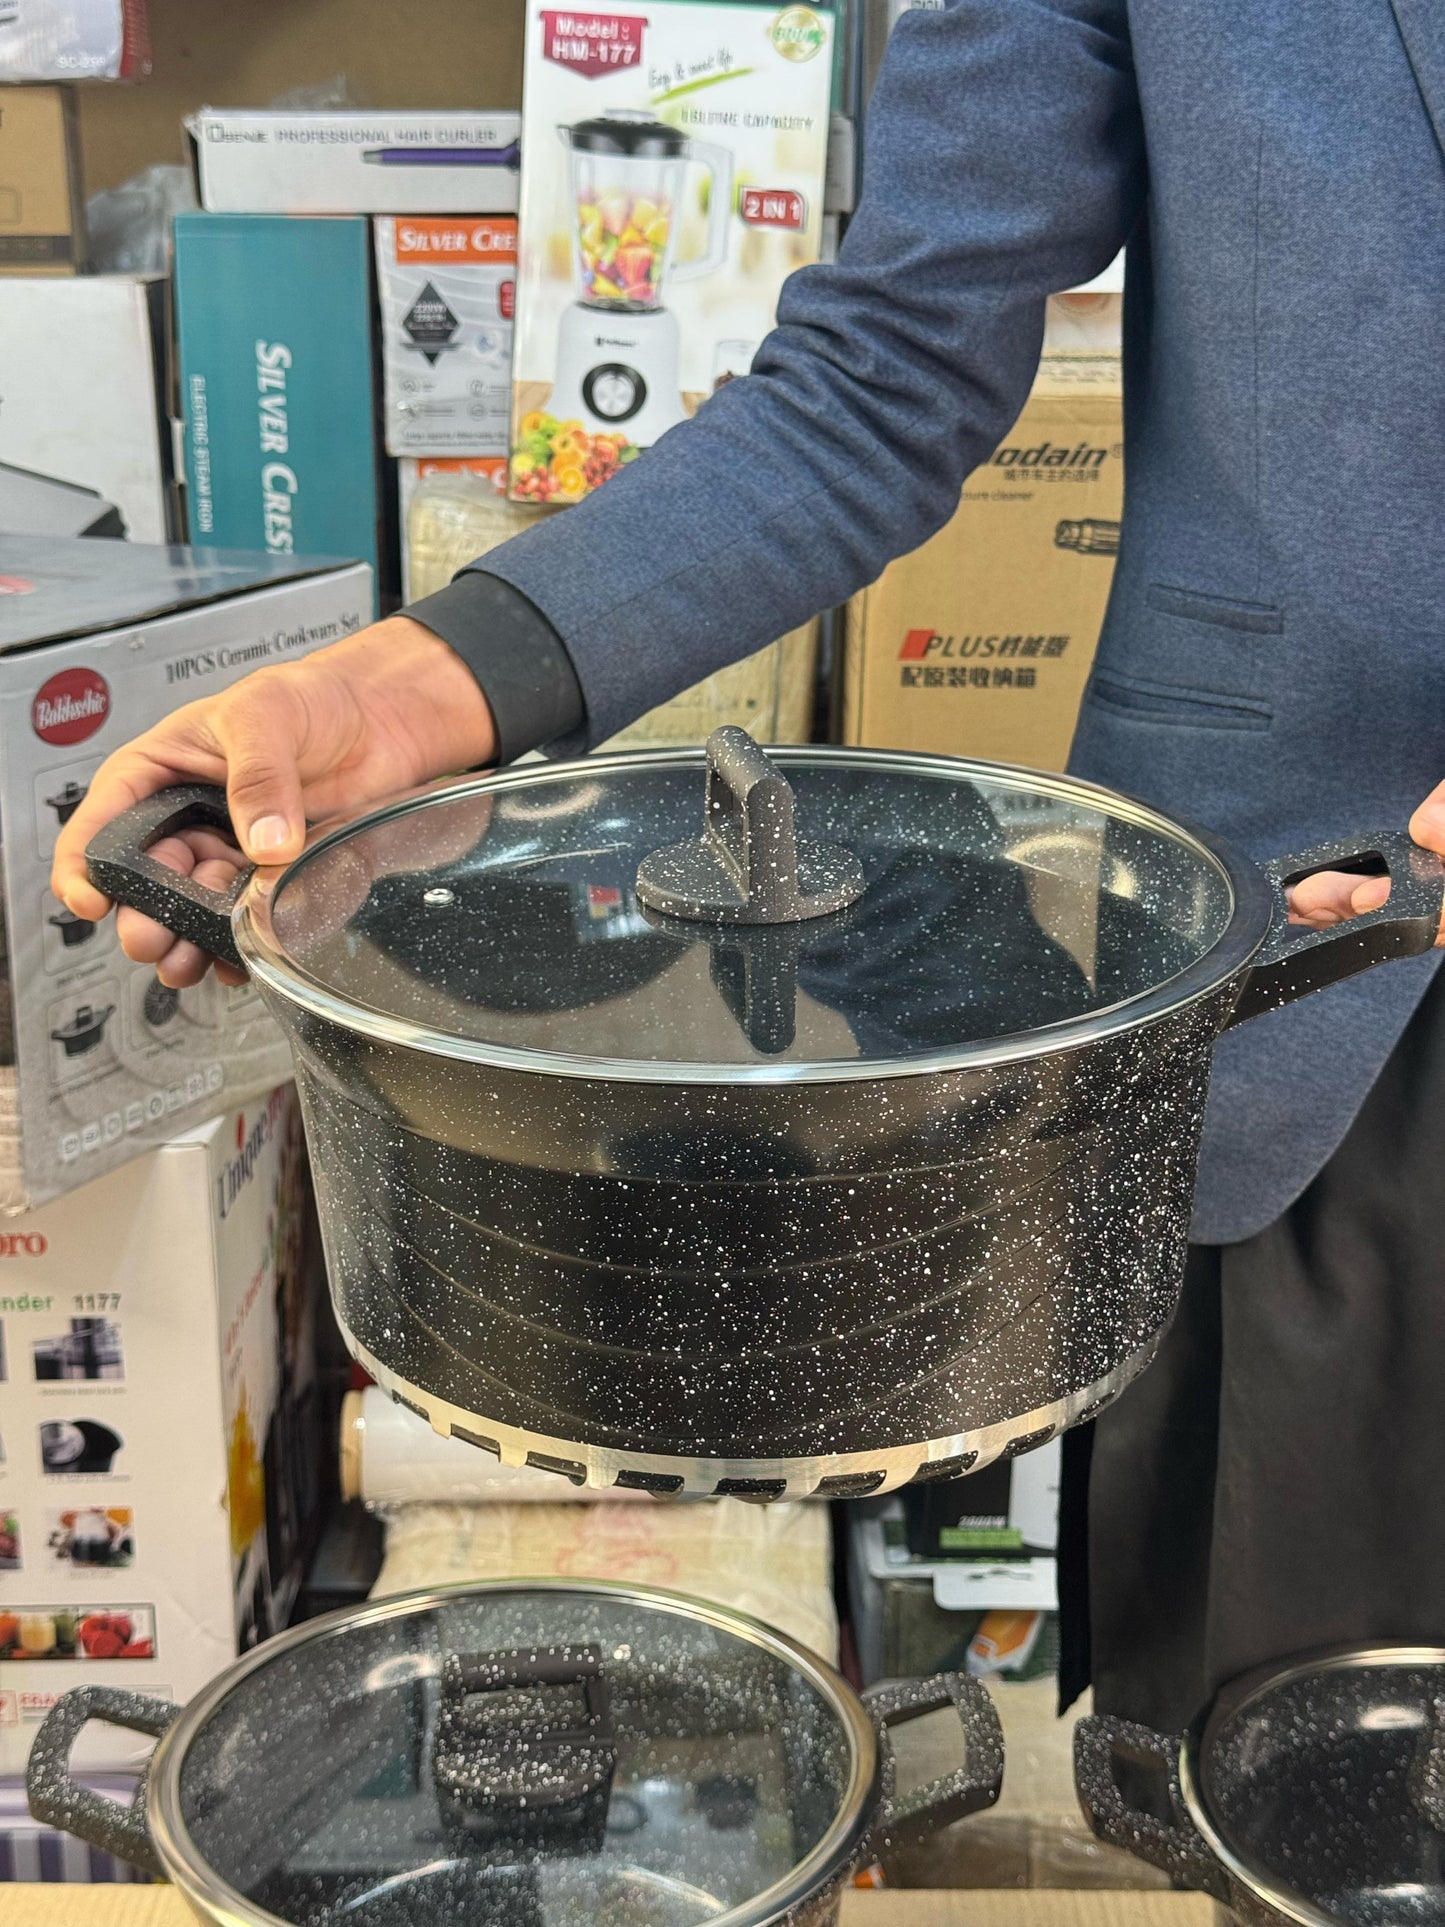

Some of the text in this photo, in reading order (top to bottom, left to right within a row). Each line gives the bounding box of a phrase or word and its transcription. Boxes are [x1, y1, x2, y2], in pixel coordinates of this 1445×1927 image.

[556, 15, 618, 39] Model
[552, 38, 635, 64] HM-177
[274, 128, 391, 145] PROFESSIONAL
[395, 128, 432, 143] HAIR
[437, 127, 498, 143] CURLER
[745, 198, 801, 220] 2 IN 1
[399, 226, 468, 251] SILVER
[255, 339, 293, 454] SILVER
[190, 373, 214, 533] ELECTRIC STEAM IRON
[166, 651, 216, 684] 10PCS
[218, 640, 272, 669] Ceramic
[273, 623, 338, 652] Cookware
[73, 1292, 121, 1312] 1177
